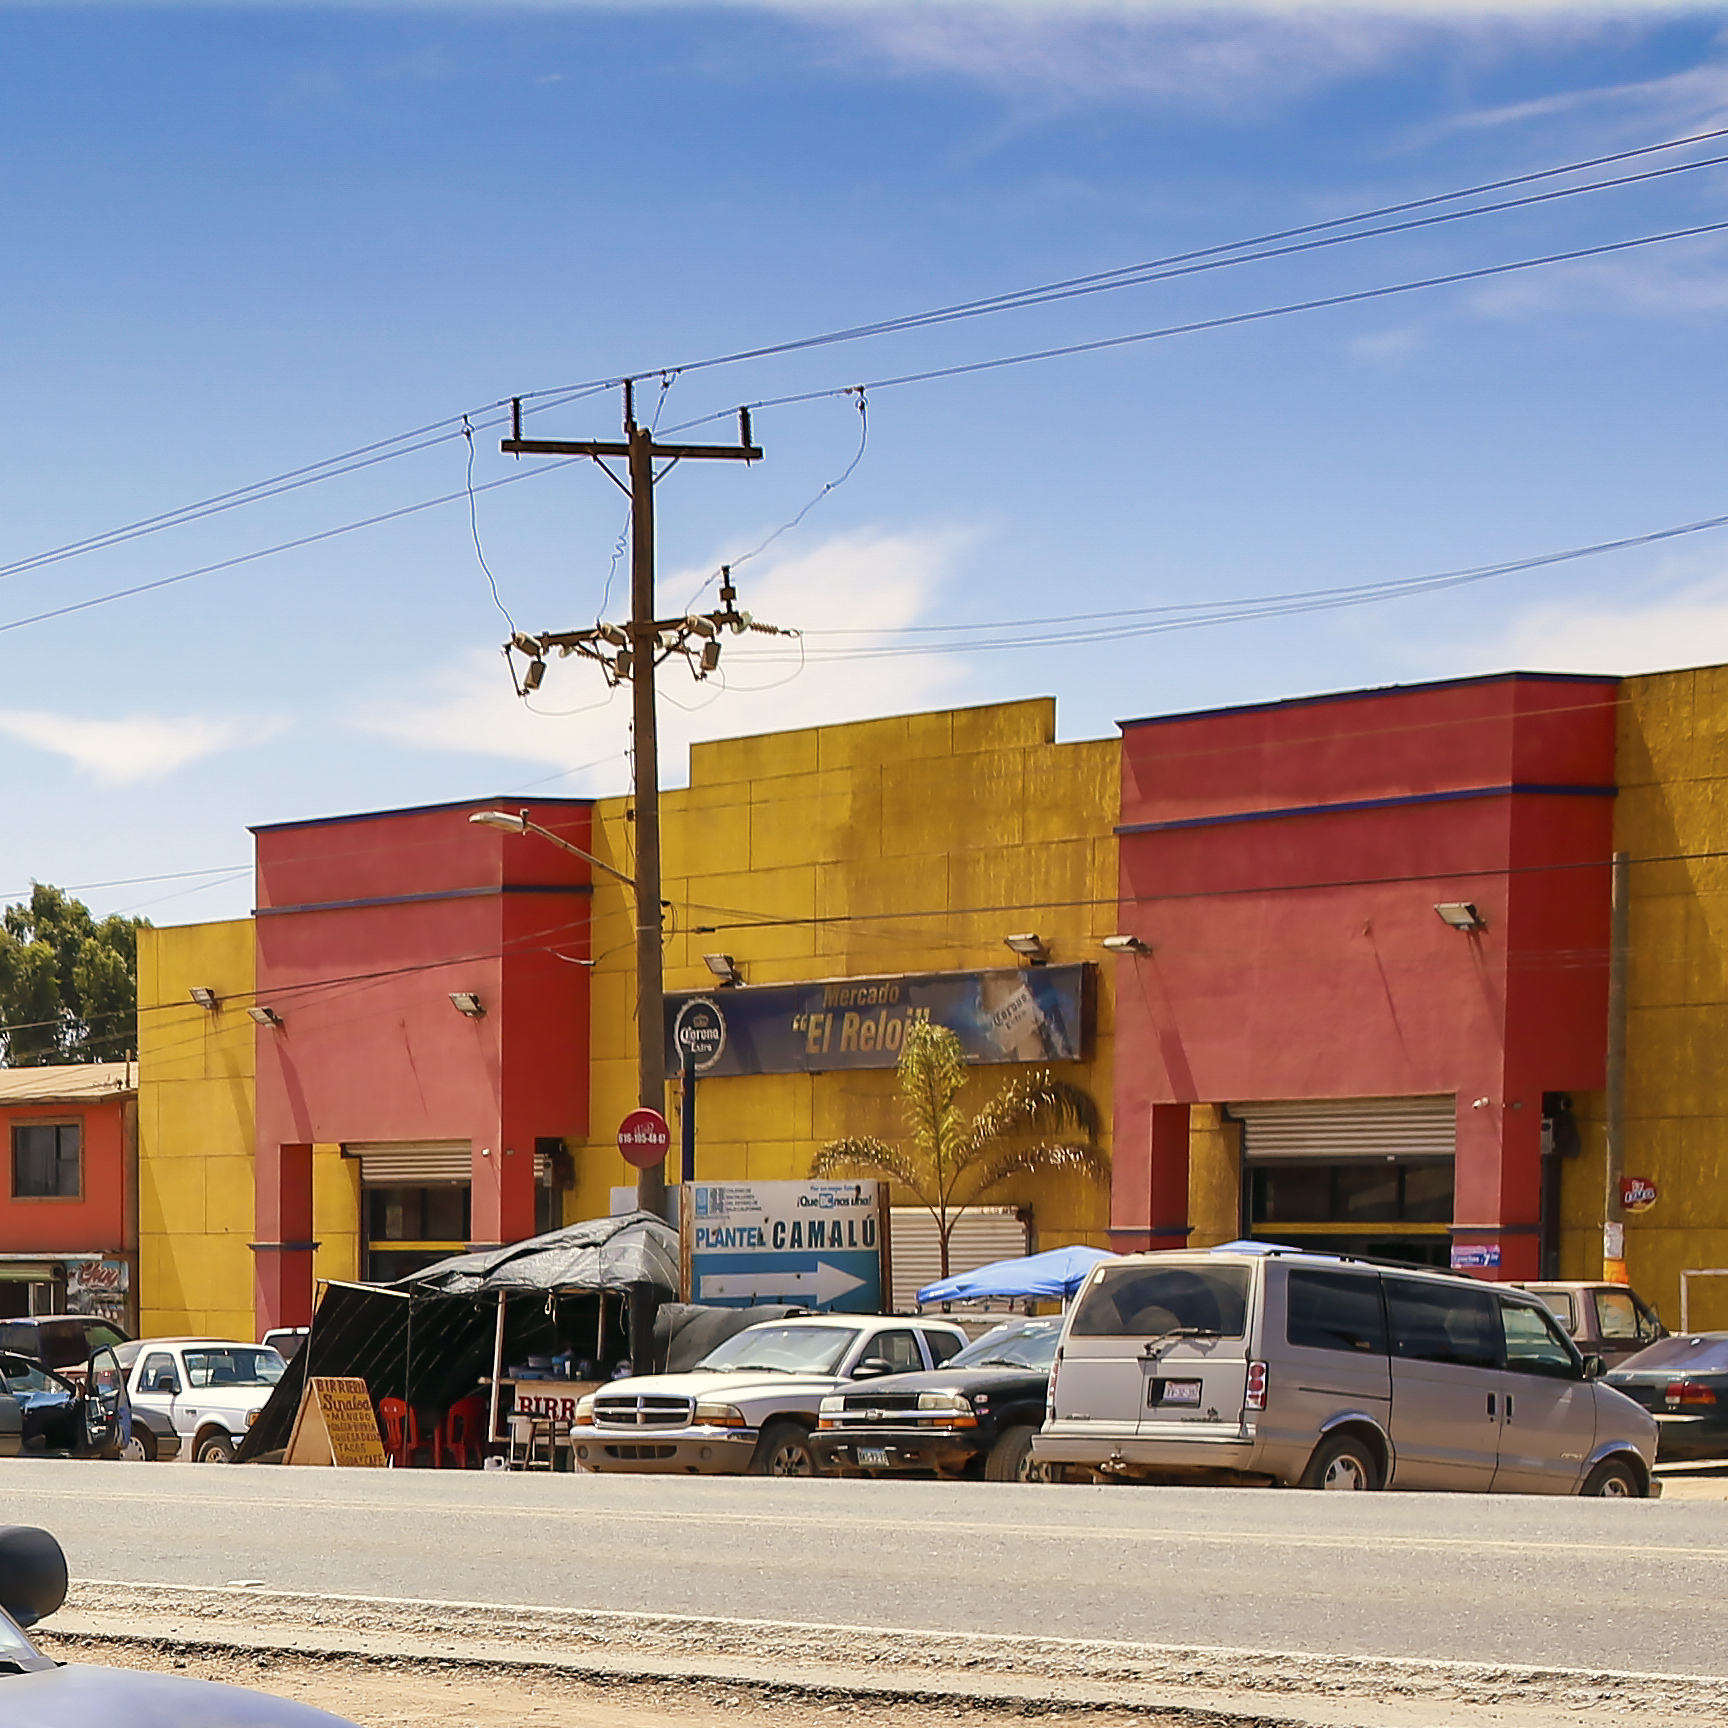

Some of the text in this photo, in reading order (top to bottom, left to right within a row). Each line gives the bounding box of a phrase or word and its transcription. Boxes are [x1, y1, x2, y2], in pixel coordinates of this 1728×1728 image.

[823, 982, 900, 1008] Mercado
[680, 1026, 719, 1045] Corona
[691, 1042, 712, 1053] Extra
[695, 1213, 876, 1250] PLANTEL CAMALÚ
[338, 1443, 367, 1453] TACOS
